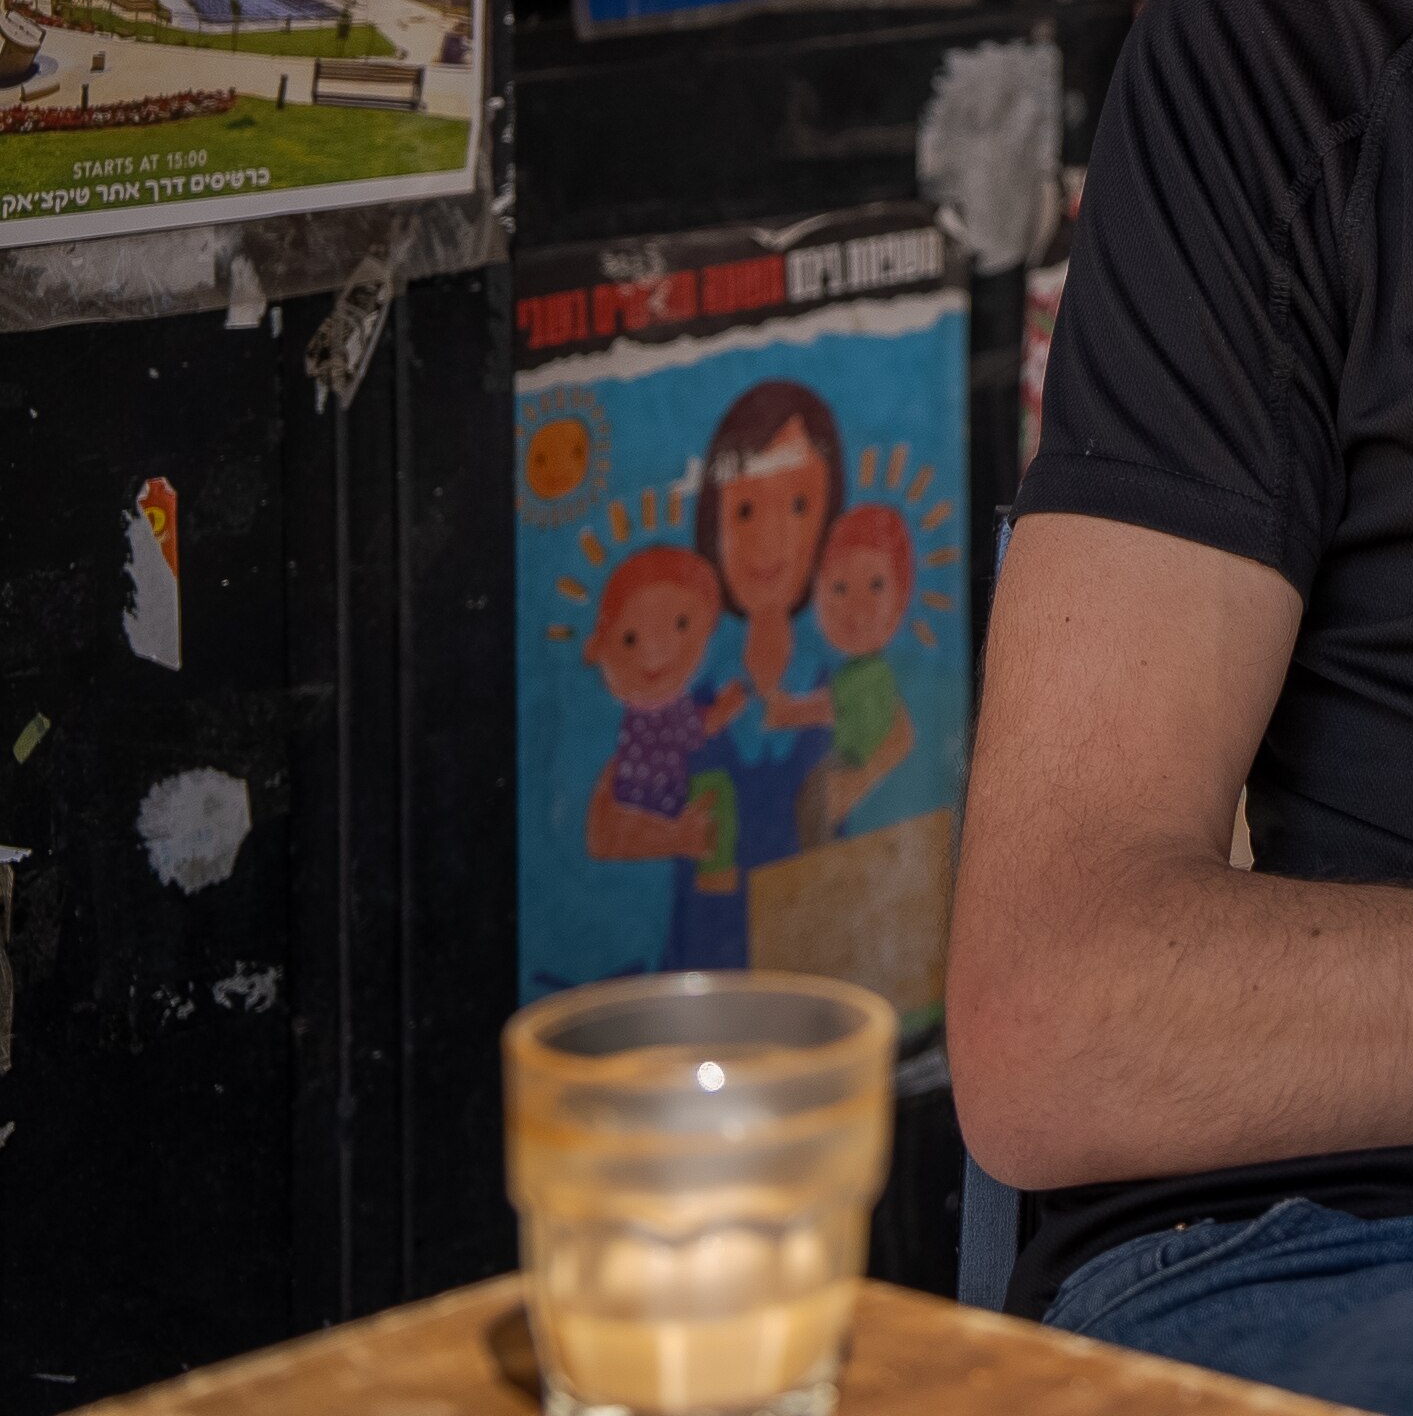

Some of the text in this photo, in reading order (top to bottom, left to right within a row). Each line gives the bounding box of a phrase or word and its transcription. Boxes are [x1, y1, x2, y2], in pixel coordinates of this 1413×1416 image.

[73, 149, 208, 180] STARTS AT 15:00
[95, 181, 140, 204] אתר
[144, 176, 187, 204] דרך
[189, 167, 271, 194] כרטיסים
